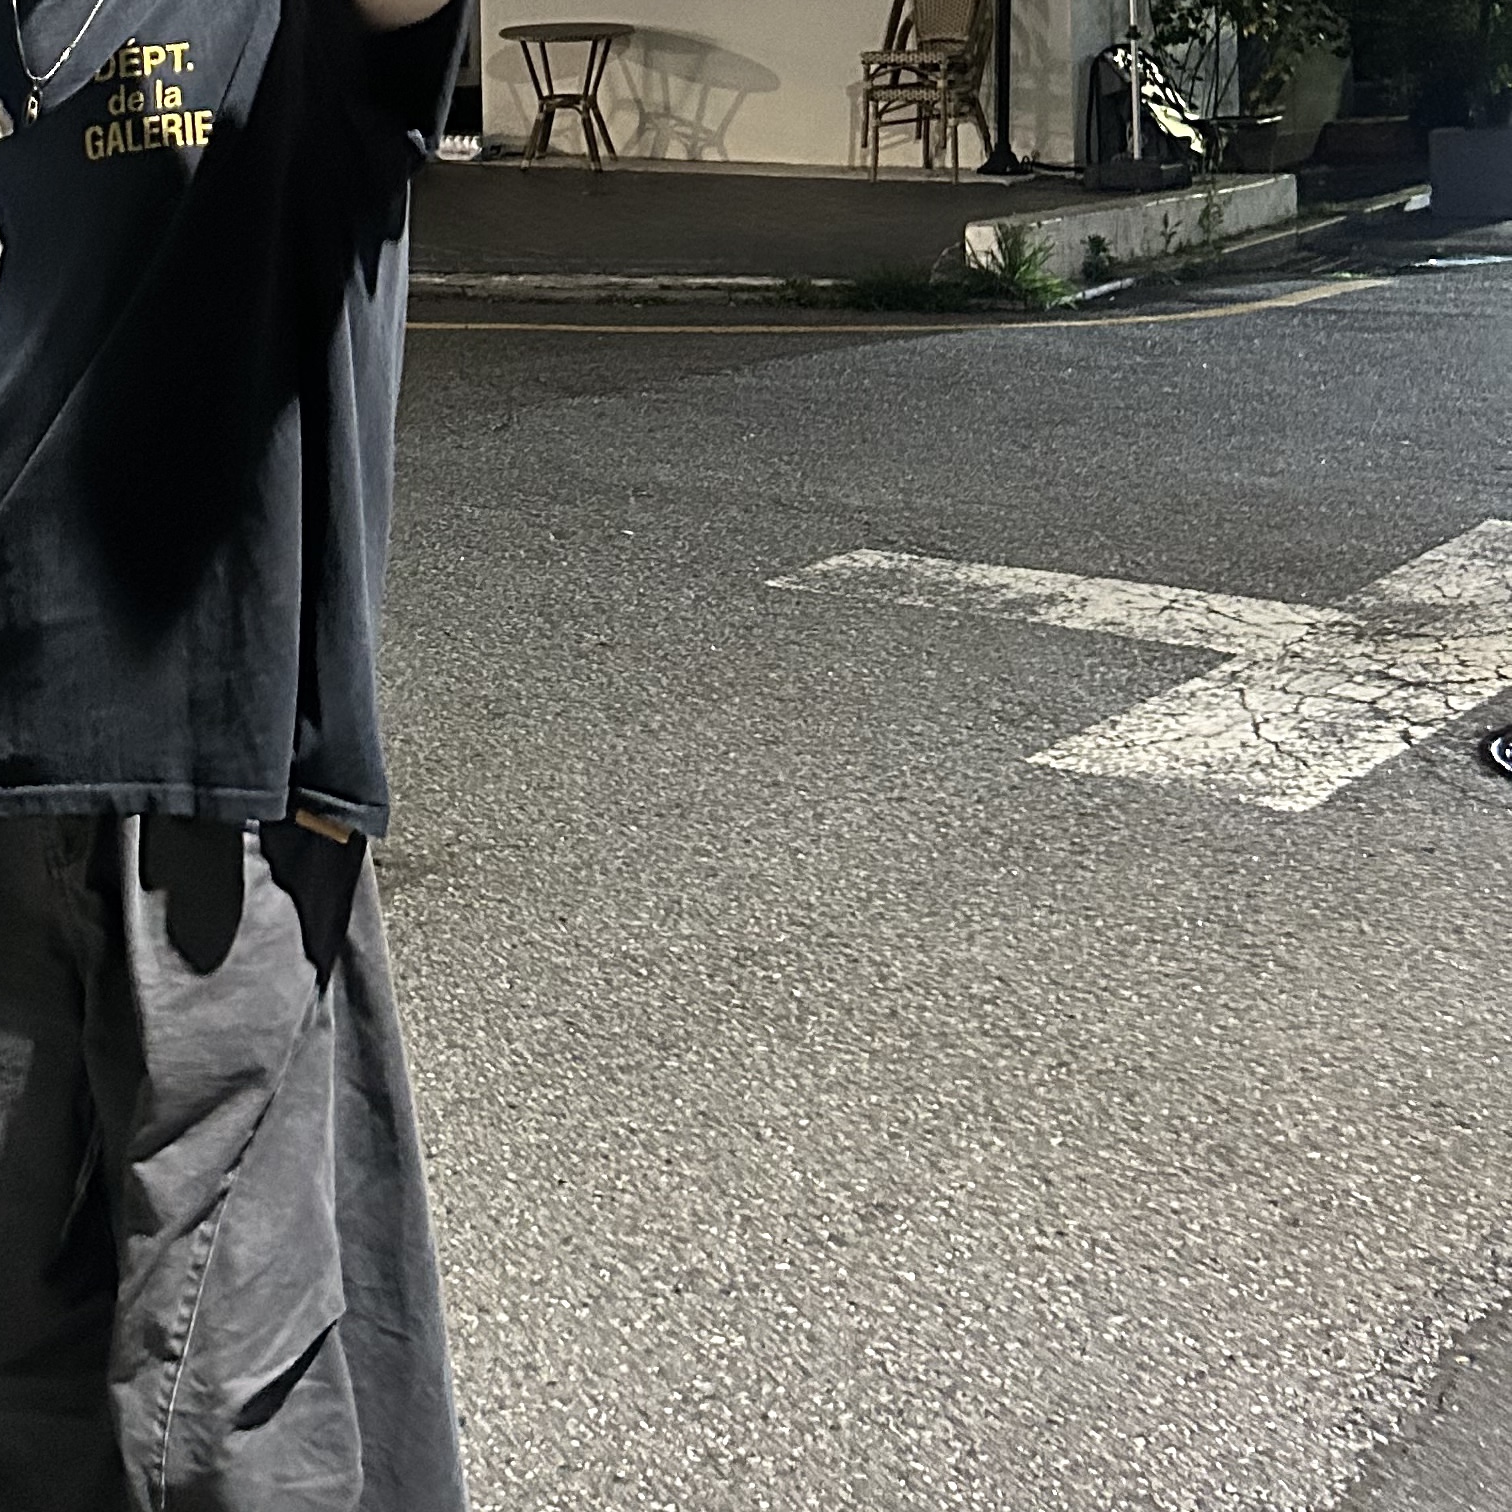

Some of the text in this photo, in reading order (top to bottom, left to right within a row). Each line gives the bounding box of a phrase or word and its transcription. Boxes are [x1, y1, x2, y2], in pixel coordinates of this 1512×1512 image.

[108, 79, 183, 116] de la
[84, 109, 213, 161] GALERIE
